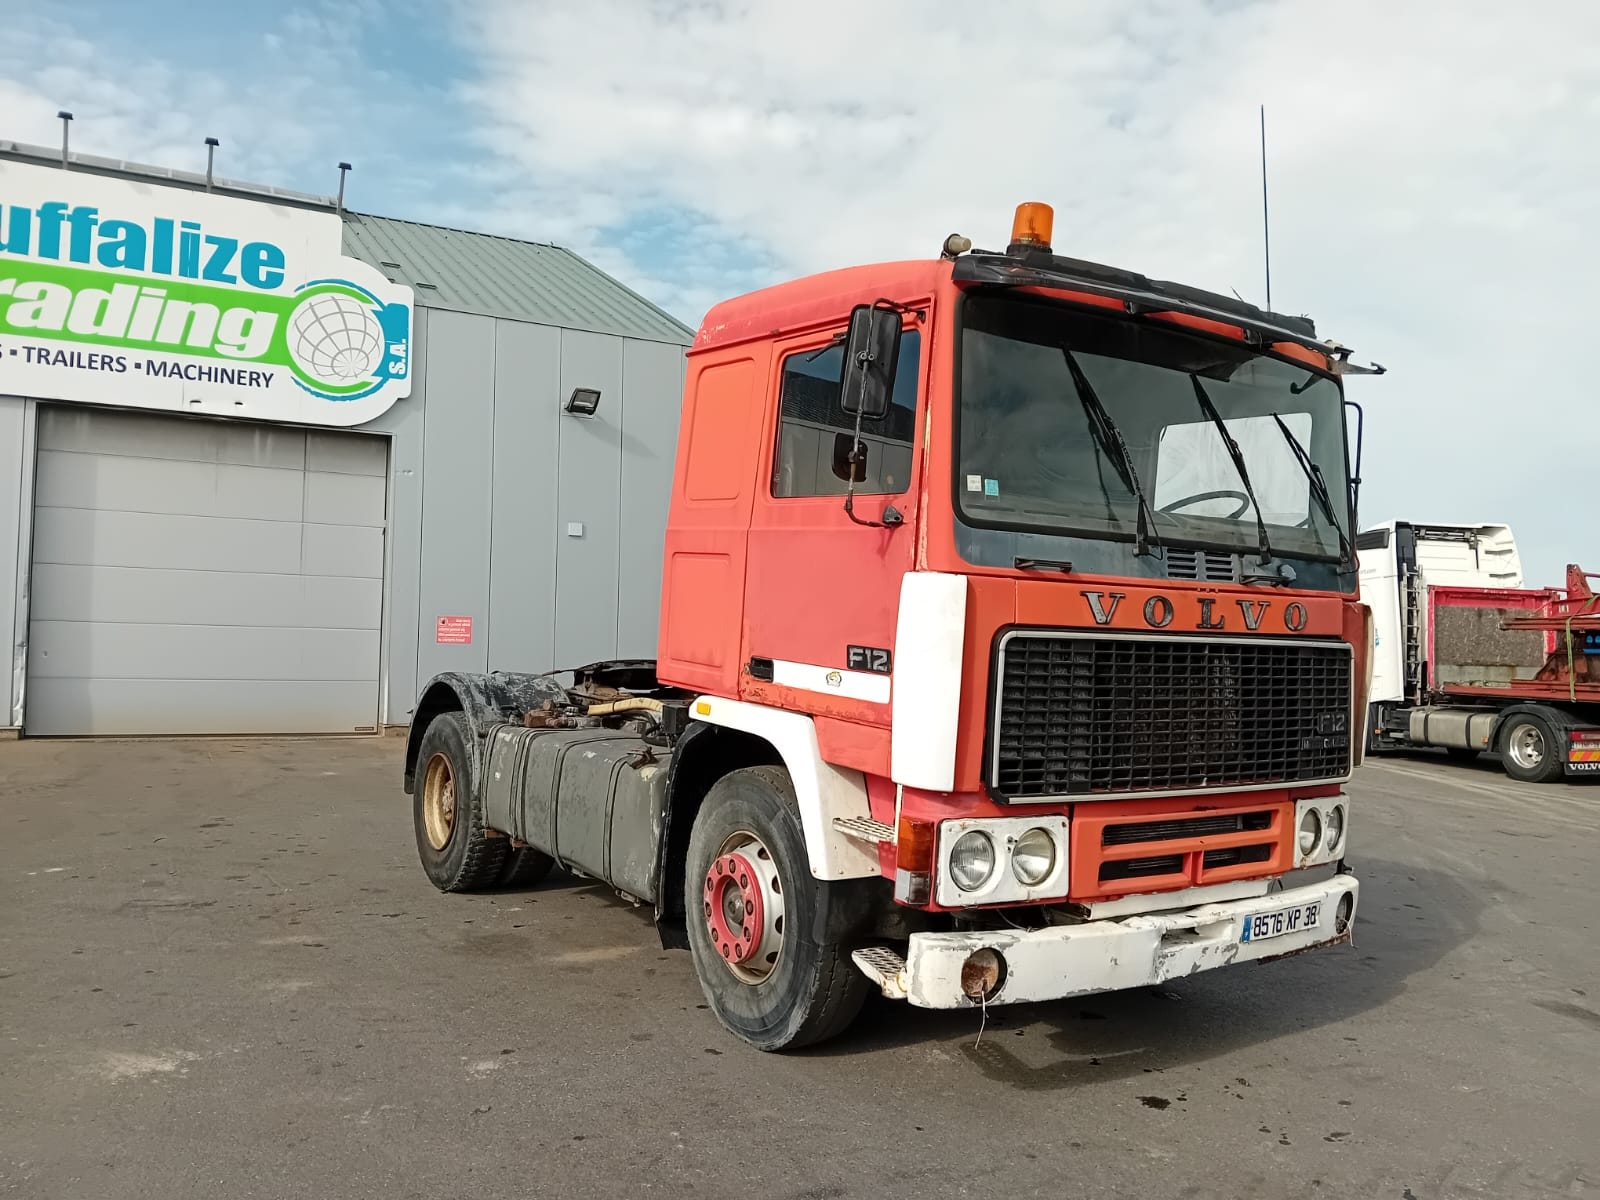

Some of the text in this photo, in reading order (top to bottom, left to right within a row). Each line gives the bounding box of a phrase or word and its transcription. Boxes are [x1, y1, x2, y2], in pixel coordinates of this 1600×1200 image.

[0, 202, 285, 289] uffalize
[22, 345, 127, 373] TRAILERS
[146, 359, 274, 388] MACHINERY
[389, 339, 406, 375] S.A.
[1080, 591, 1308, 632] VOLVO
[849, 648, 888, 671] F12
[1320, 713, 1345, 732] F12
[1253, 905, 1318, 937] 8576 XP 38
